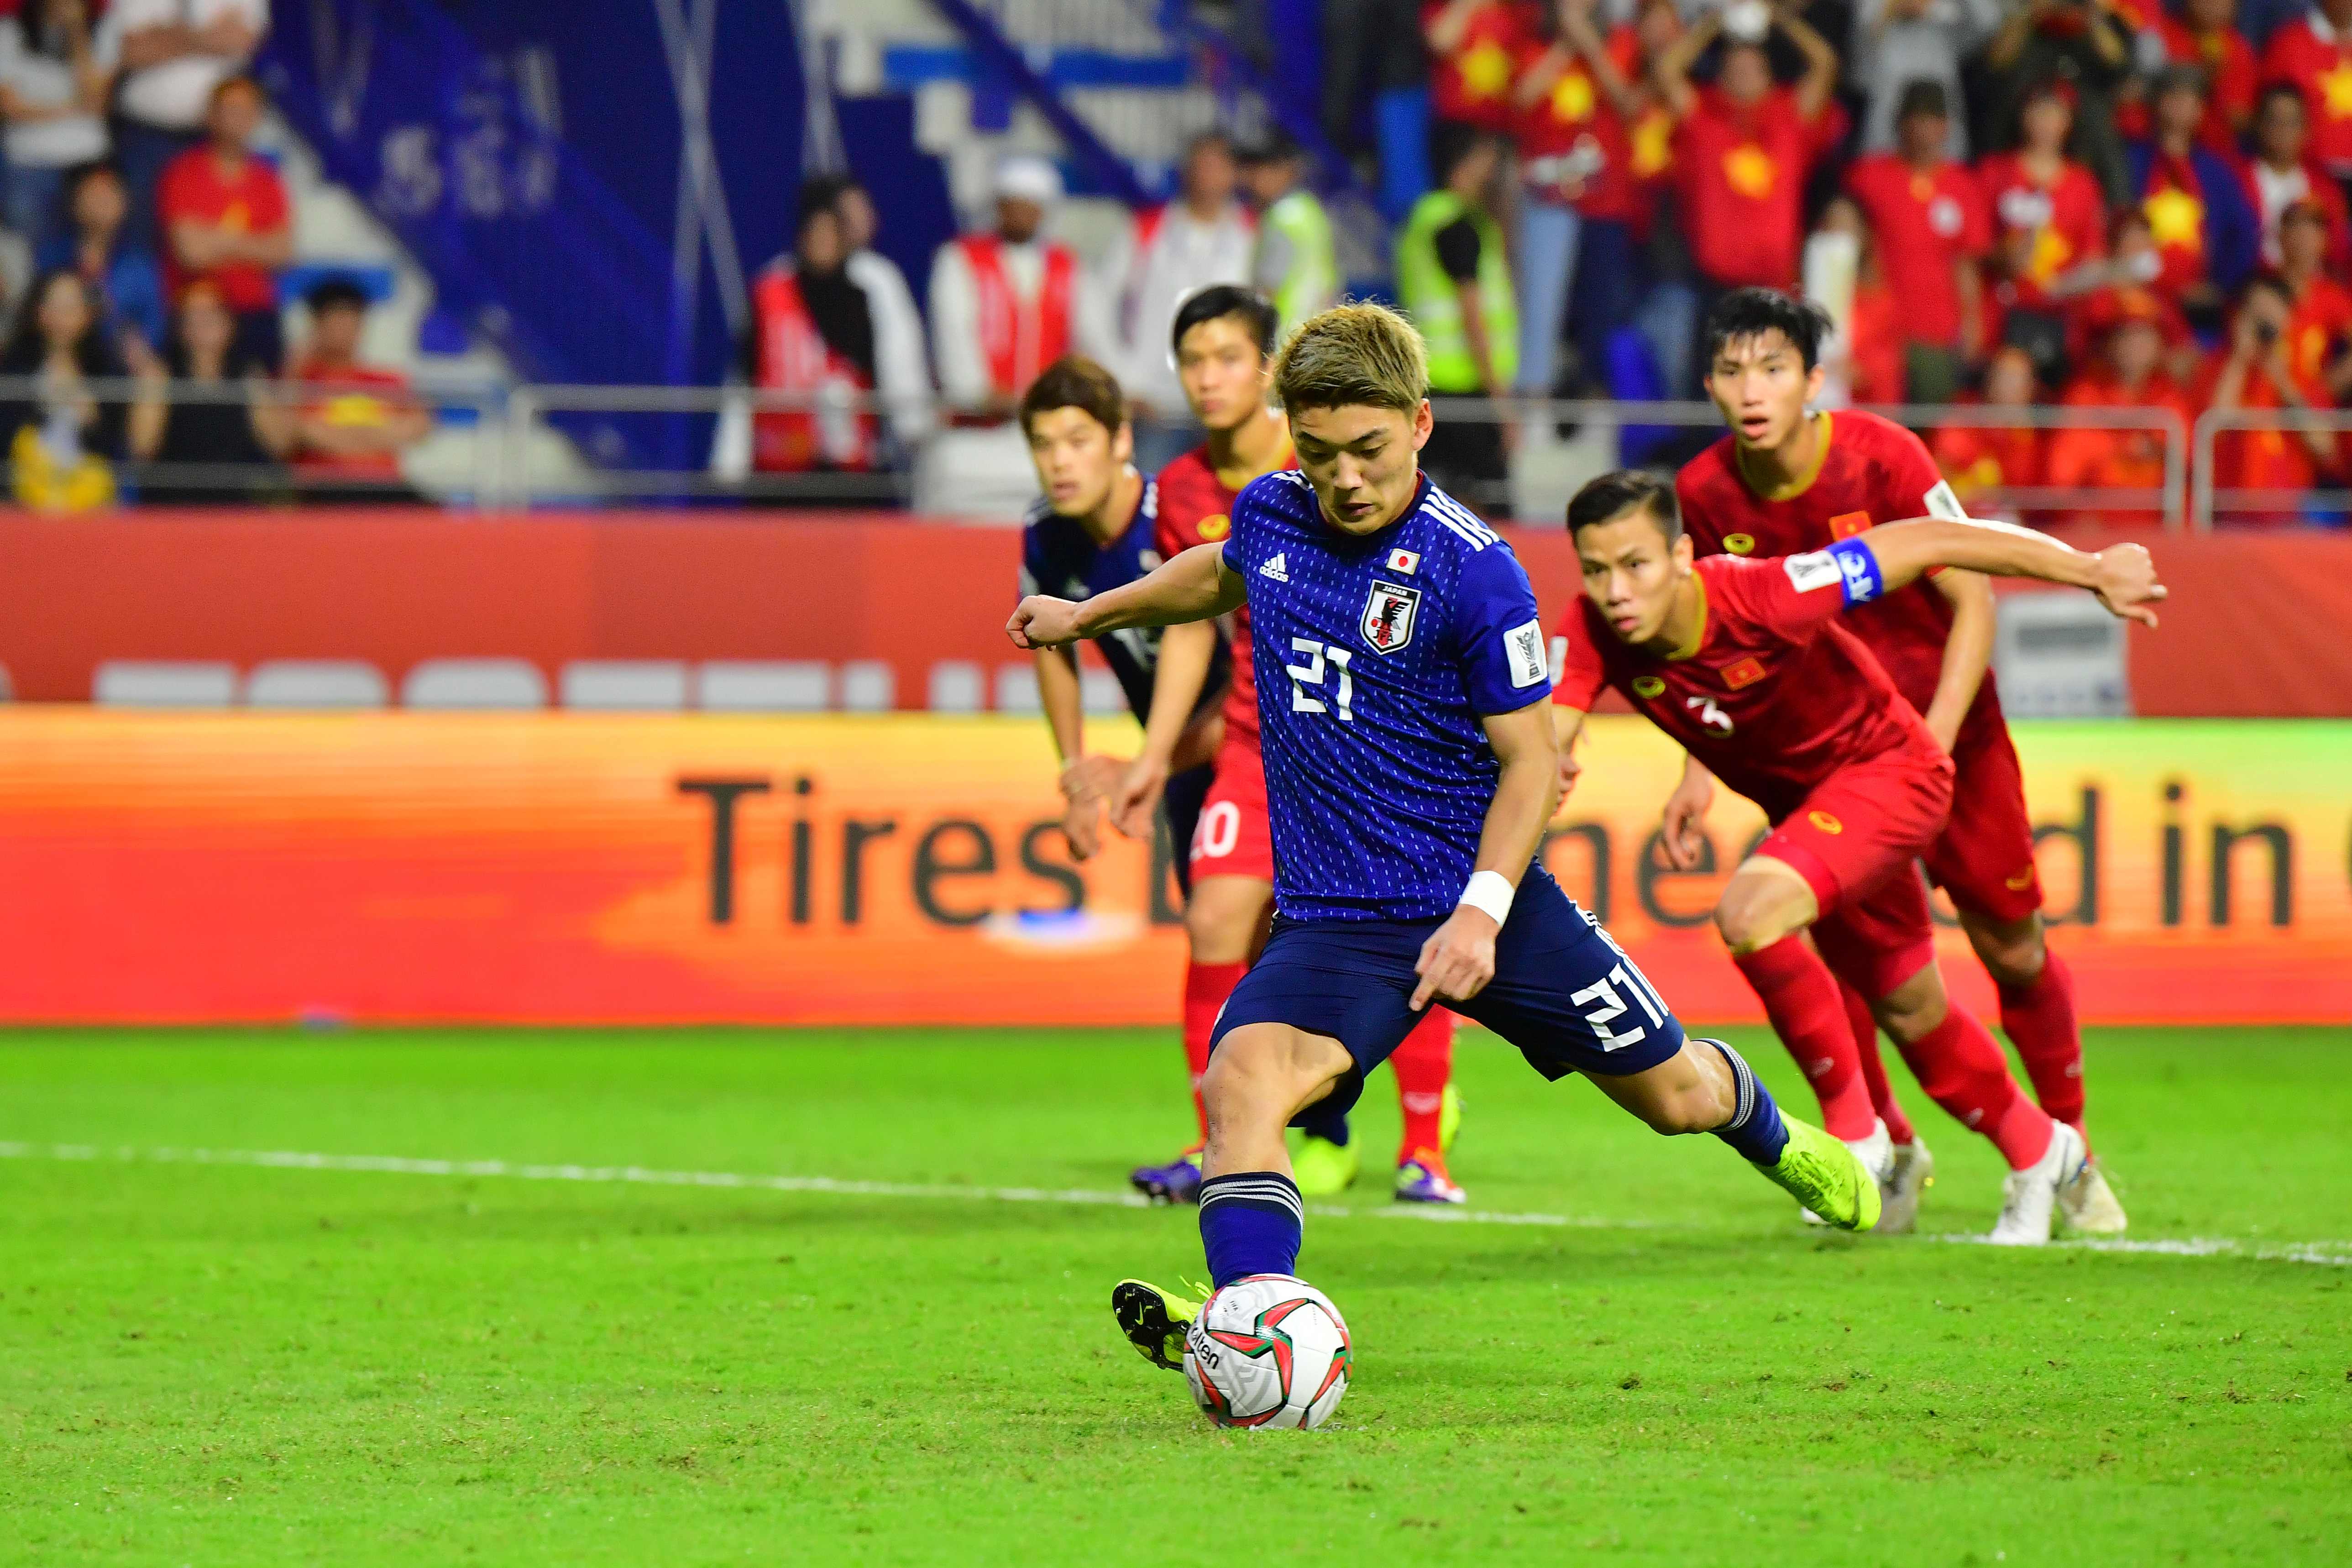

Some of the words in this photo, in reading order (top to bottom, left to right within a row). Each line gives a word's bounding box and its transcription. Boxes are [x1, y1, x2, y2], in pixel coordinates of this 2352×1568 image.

[1259, 566, 1289, 582] adidas
[1382, 586, 1408, 596] JAPAN
[1372, 629, 1394, 643] JFA
[1286, 637, 1353, 721] 21
[1687, 696, 1734, 739] 3
[677, 778, 1085, 927] Tires
[2163, 783, 2290, 927] in
[1570, 962, 1664, 1052] 21
[1191, 1318, 1219, 1369] olten
